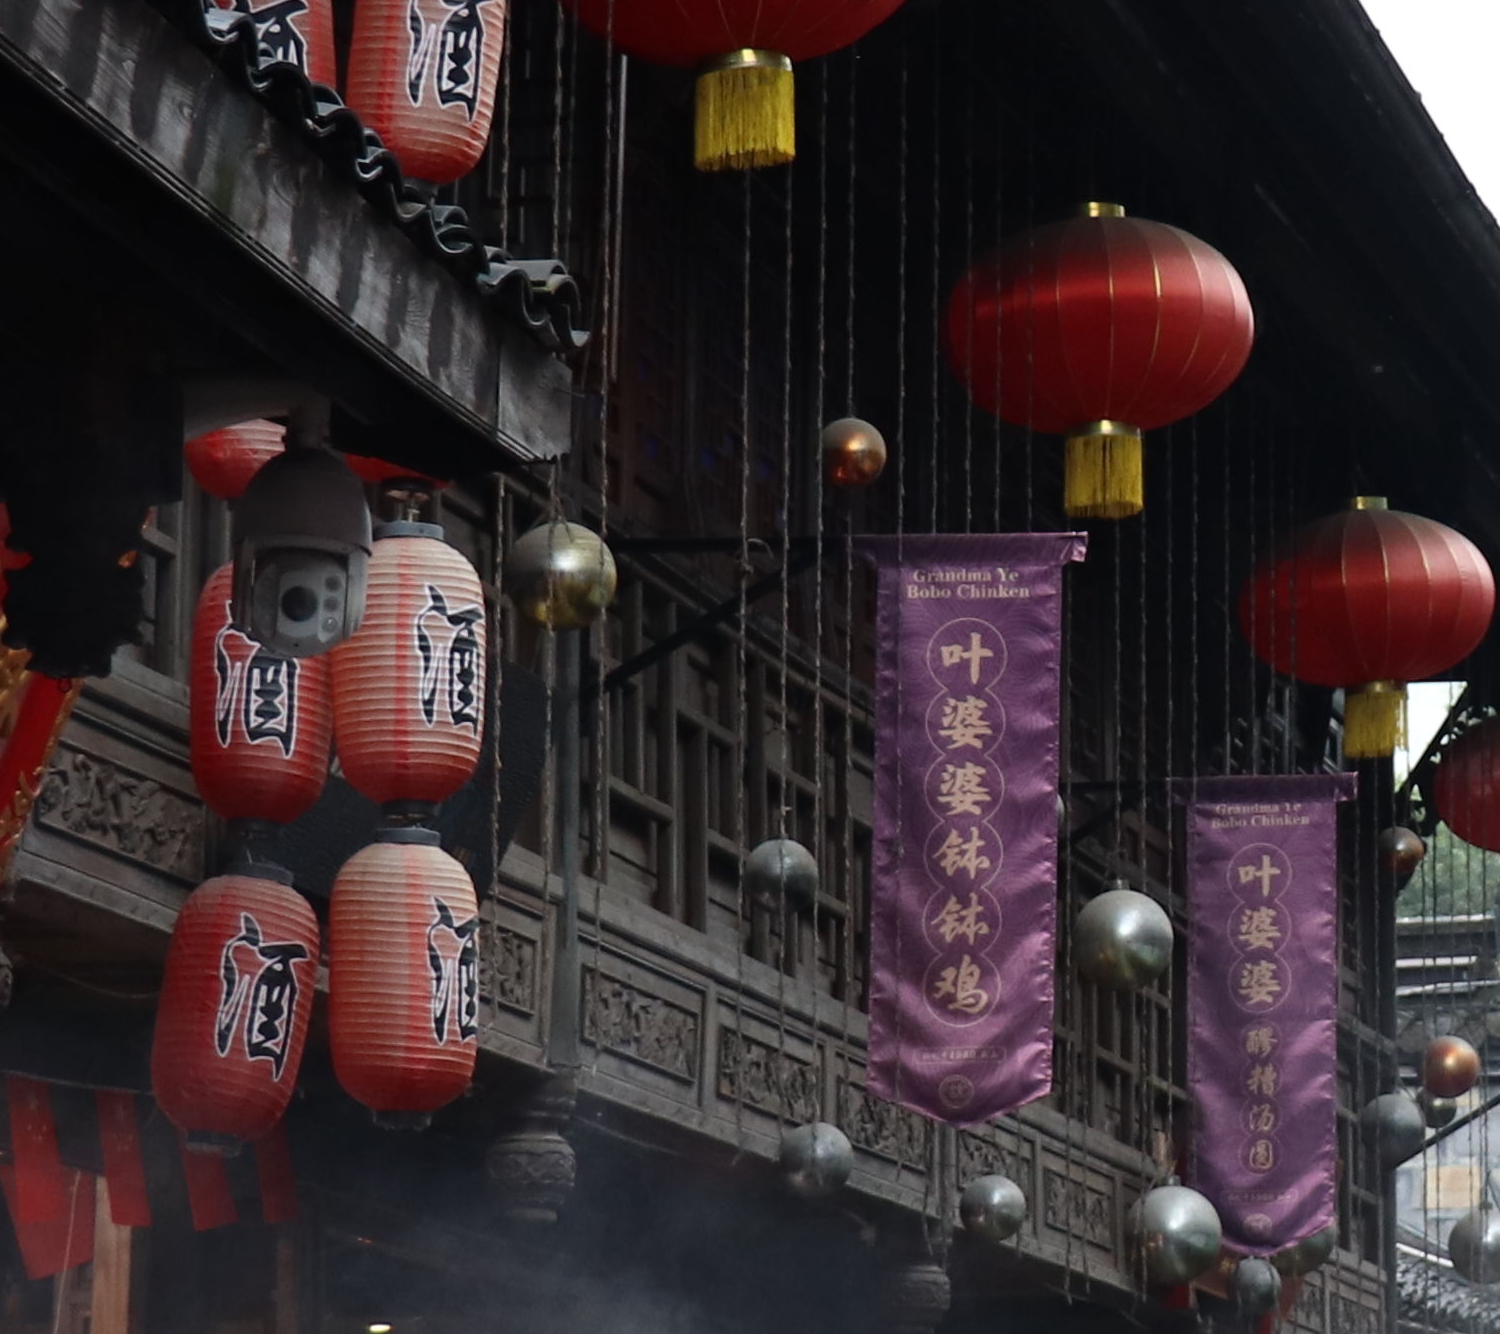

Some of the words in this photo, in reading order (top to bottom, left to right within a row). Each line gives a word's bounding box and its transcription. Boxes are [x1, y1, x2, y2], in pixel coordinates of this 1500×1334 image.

[906, 585, 951, 599] Bobo
[956, 584, 1030, 599] Chinken
[912, 568, 992, 582] Grandma
[996, 567, 1019, 582] Ye
[931, 631, 995, 1014] 叶婆婆钵钵鸡
[213, 911, 309, 1082] 酒
[1237, 853, 1282, 1005] 叶婆婆
